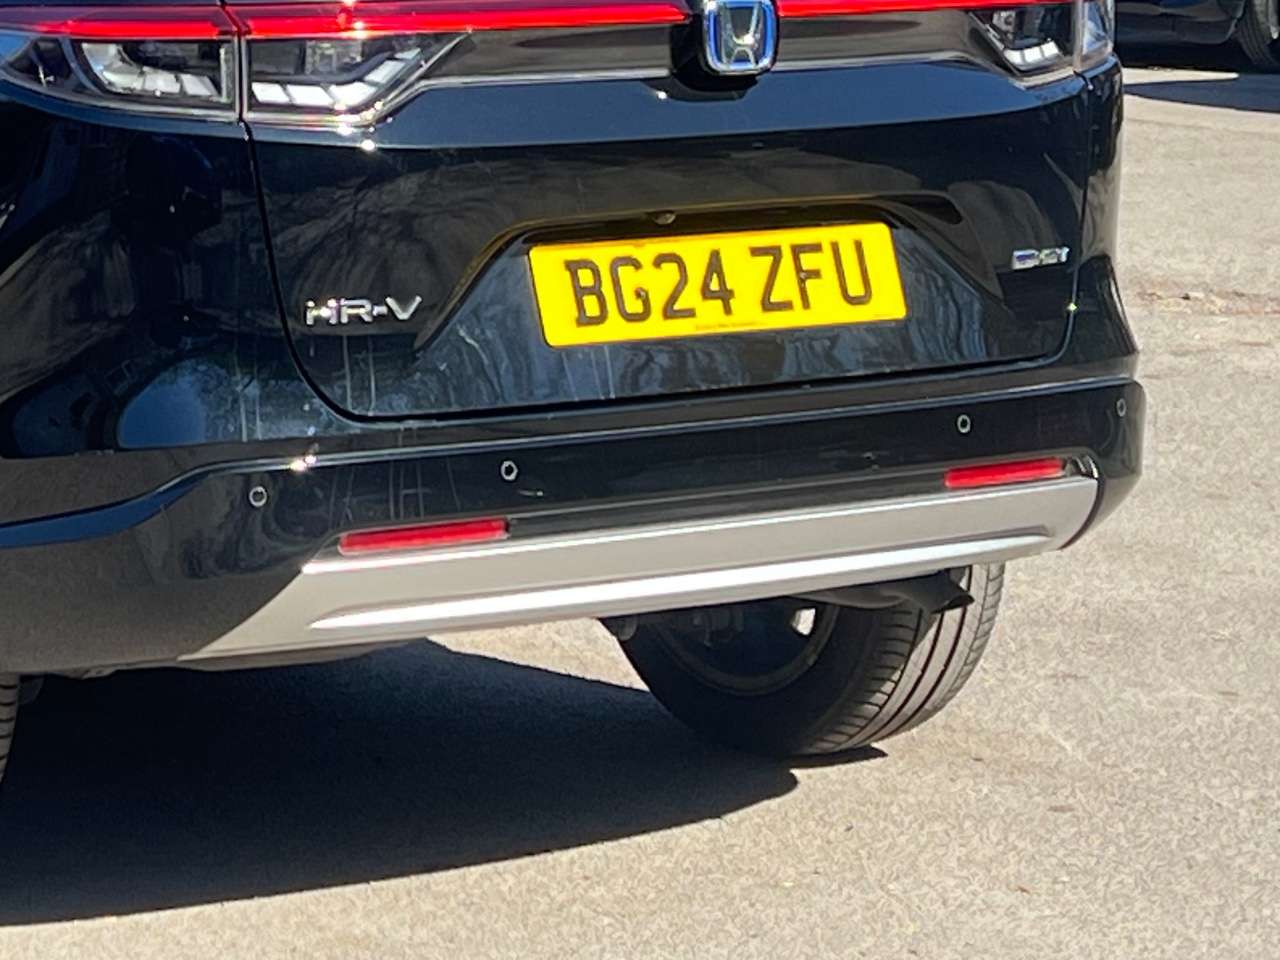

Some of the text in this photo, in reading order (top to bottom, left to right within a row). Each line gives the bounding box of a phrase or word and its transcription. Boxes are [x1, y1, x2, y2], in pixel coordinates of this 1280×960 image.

[305, 294, 423, 326] HR-V
[564, 239, 873, 328] BG24 ZFU
